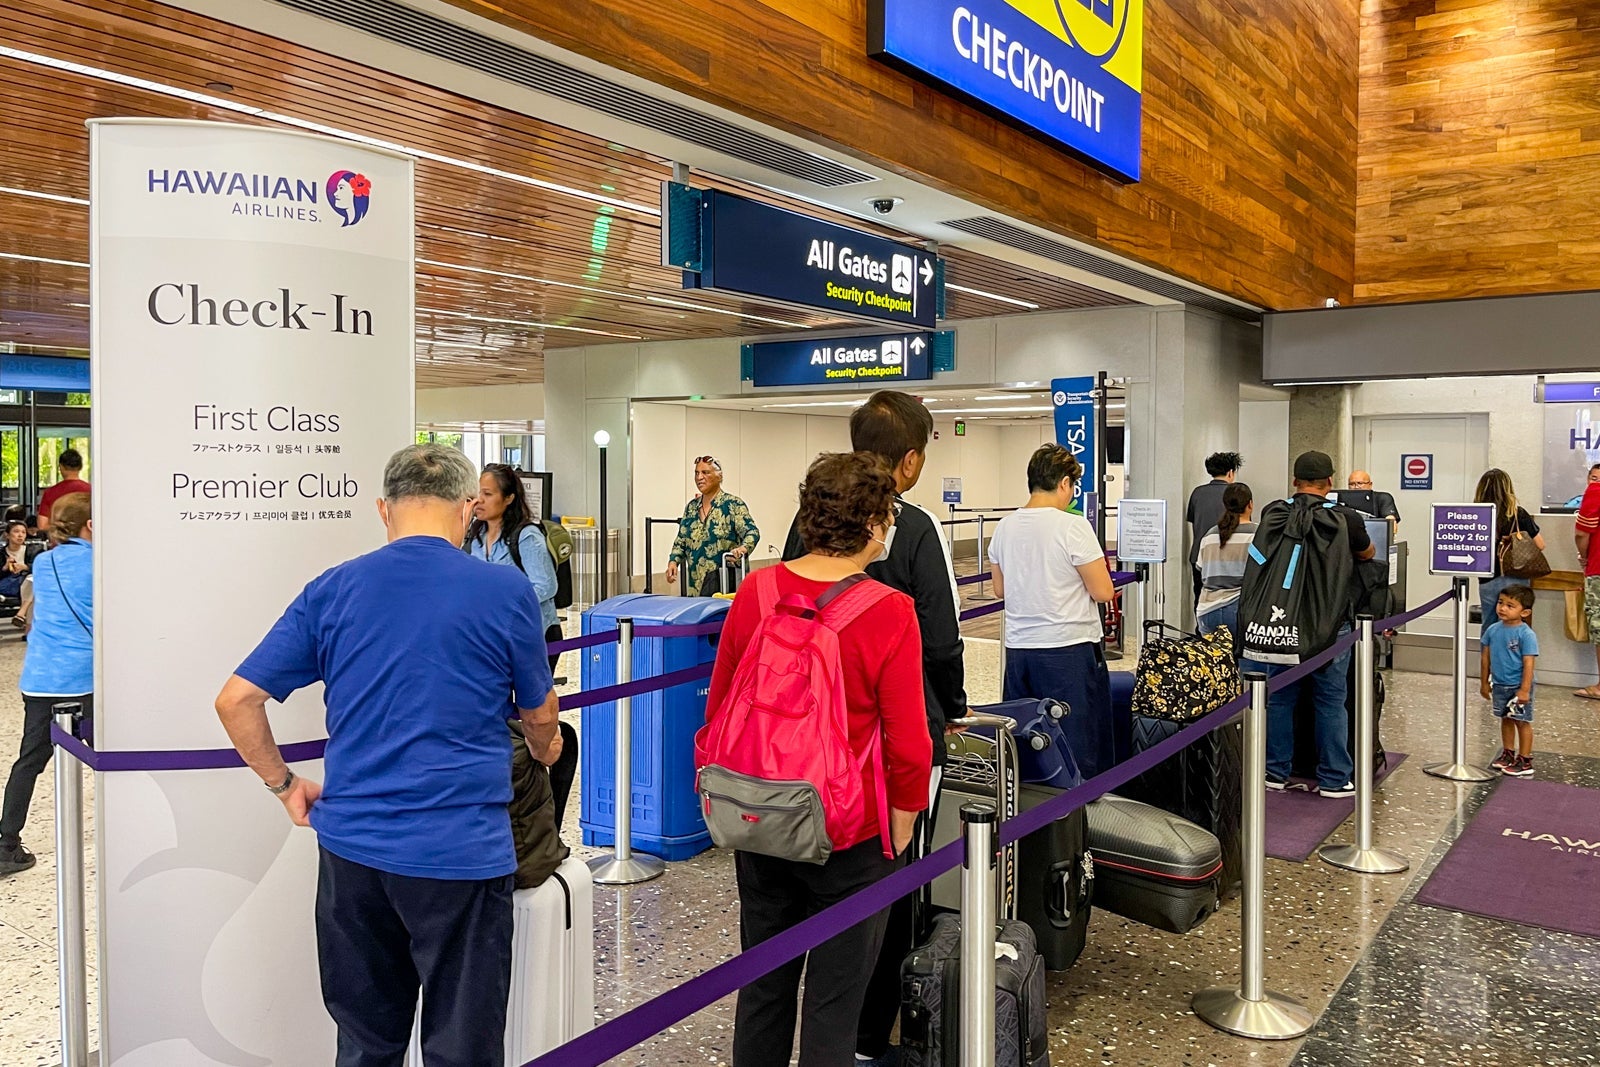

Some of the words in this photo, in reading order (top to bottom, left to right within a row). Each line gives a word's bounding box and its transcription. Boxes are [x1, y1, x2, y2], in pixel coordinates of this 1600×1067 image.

[952, 6, 1105, 133] CHECKPOINT
[148, 169, 318, 204] HAWAIIAN
[806, 239, 834, 271] All
[838, 247, 887, 283] Gates
[826, 282, 864, 306] Security
[865, 290, 912, 313] Checkpoint
[148, 283, 375, 336] Check-In
[810, 347, 832, 365] All
[834, 347, 877, 364] Gates
[825, 367, 857, 379] Security
[857, 365, 902, 378] Checkpoint
[194, 404, 258, 431] First
[267, 406, 340, 432] Class
[173, 473, 289, 499] Premier
[298, 473, 358, 498] Club
[1447, 511, 1479, 520] Please
[1437, 523, 1476, 531] proceed
[1477, 523, 1488, 531] to
[1436, 532, 1465, 542] Lobby
[1467, 533, 1473, 541] 2
[1475, 533, 1489, 541] for
[1437, 543, 1488, 552] assistance
[1246, 621, 1299, 638] HANDLE
[1245, 632, 1272, 645] WITH
[1273, 637, 1299, 646] CARE
